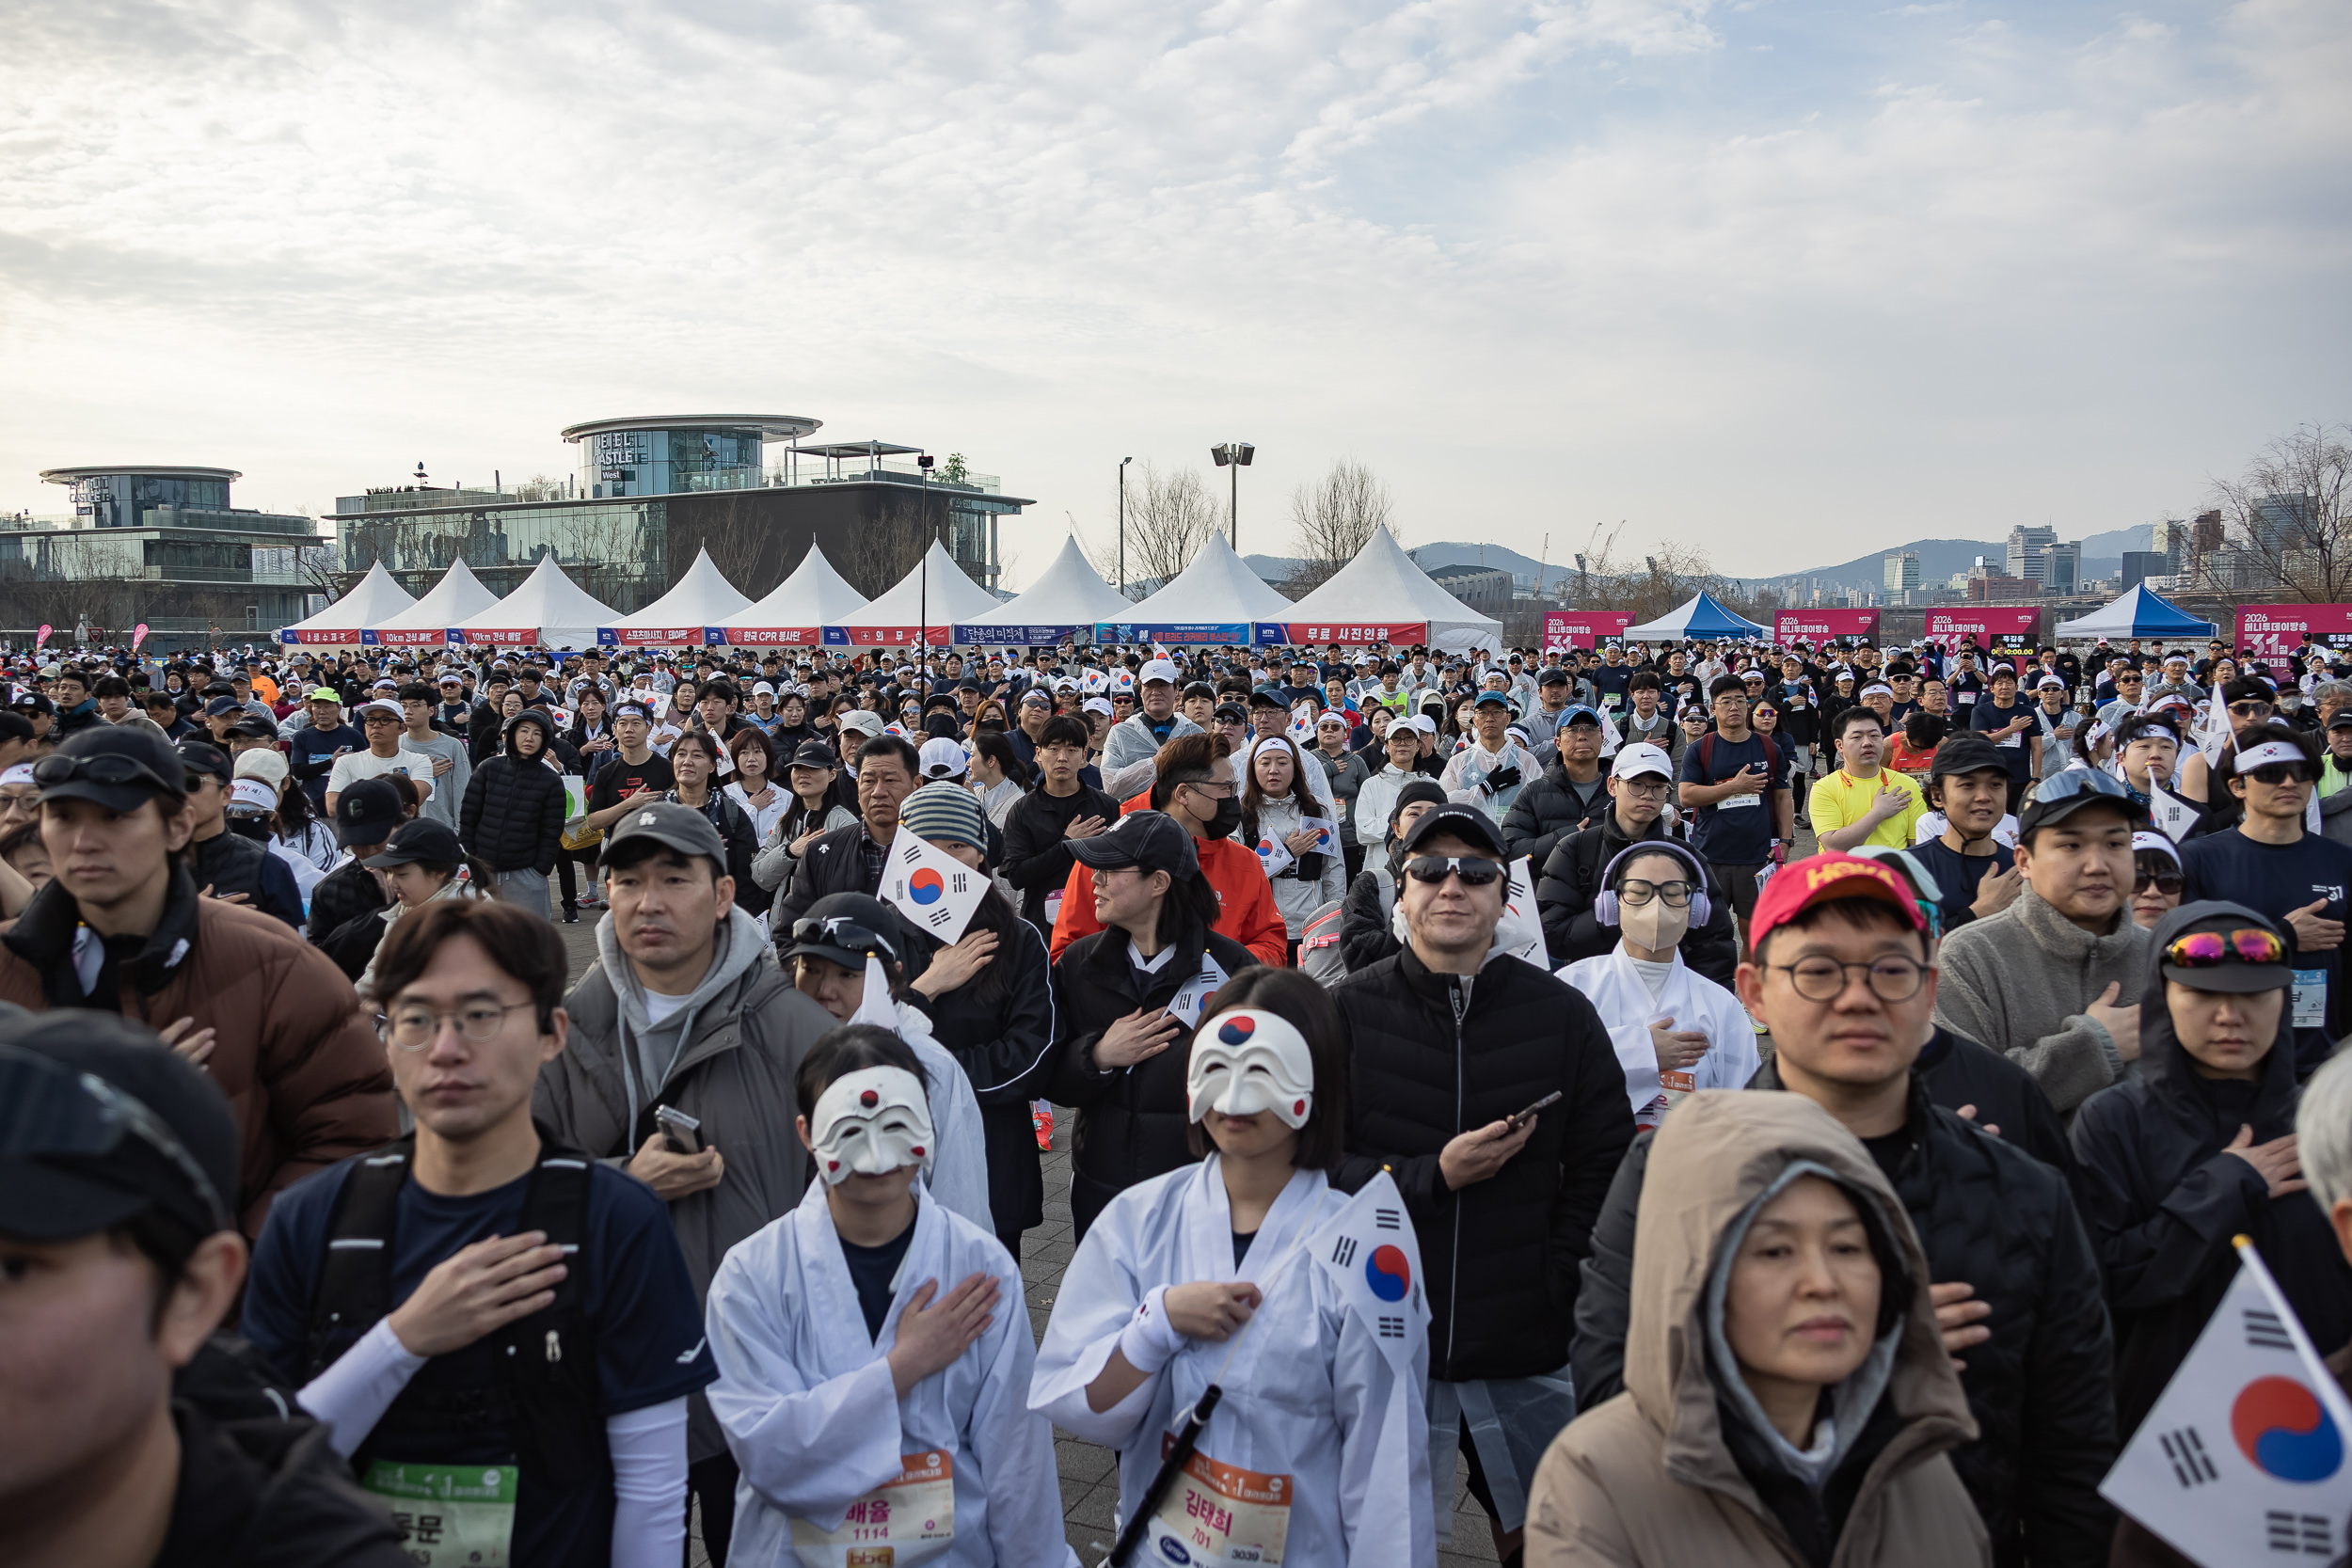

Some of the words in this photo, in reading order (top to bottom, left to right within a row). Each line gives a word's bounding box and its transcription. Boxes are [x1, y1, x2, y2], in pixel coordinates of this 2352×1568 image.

[593, 451, 633, 466] CASTLE
[1548, 618, 1565, 626] 2026
[2245, 614, 2268, 623] 2026
[1780, 625, 1830, 633] 머니투데이방송
[1932, 624, 1986, 633] 머니투데이방송
[2245, 622, 2308, 632] 머니투데이방송
[386, 633, 404, 642] 10km
[471, 632, 491, 641] 10km
[626, 629, 662, 640] 스포츠마사지
[743, 631, 757, 642] 한국
[758, 631, 777, 642] CPR
[778, 631, 801, 642] 봉사단
[967, 626, 995, 641] 단종의
[1165, 632, 1182, 642] 트리드
[1184, 632, 1208, 642] 리커버리
[1209, 632, 1229, 642] 부스터
[1307, 627, 1331, 641] 무료
[1337, 627, 1389, 641] 사진인화
[1806, 861, 1896, 891] HOKA
[1186, 1488, 1233, 1538] 김태희
[853, 1526, 889, 1542] 1114
[1191, 1526, 1211, 1549] 701
[1163, 1539, 1187, 1560] Carrier
[1232, 1547, 1261, 1561] 3039
[849, 1550, 893, 1568] bbq
